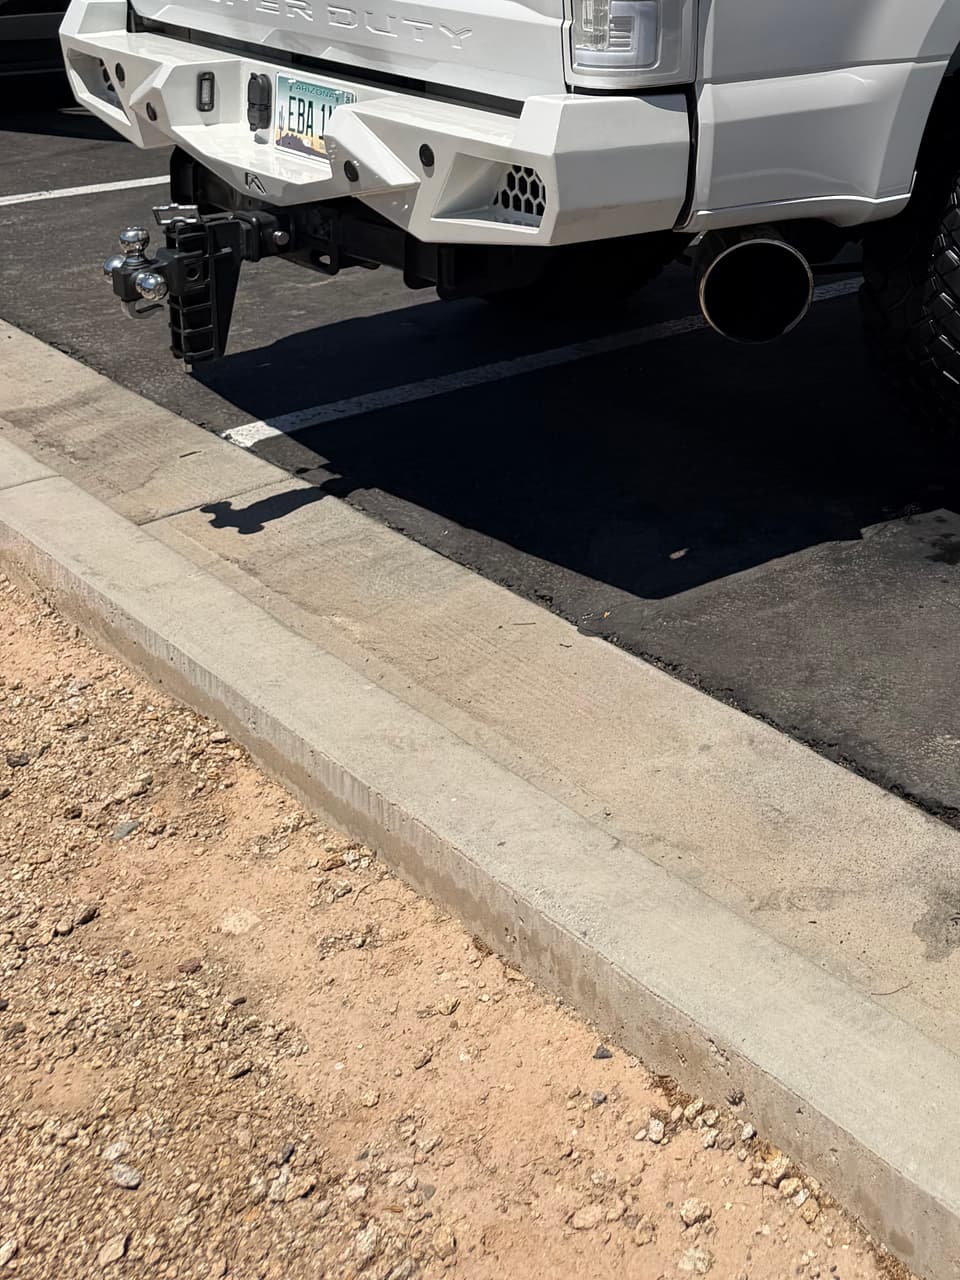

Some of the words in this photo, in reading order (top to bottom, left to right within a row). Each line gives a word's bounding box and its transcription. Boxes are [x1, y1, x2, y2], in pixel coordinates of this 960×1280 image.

[327, 4, 473, 49] DUTY
[295, 84, 335, 99] ARIZONA
[288, 96, 313, 137] EBA
